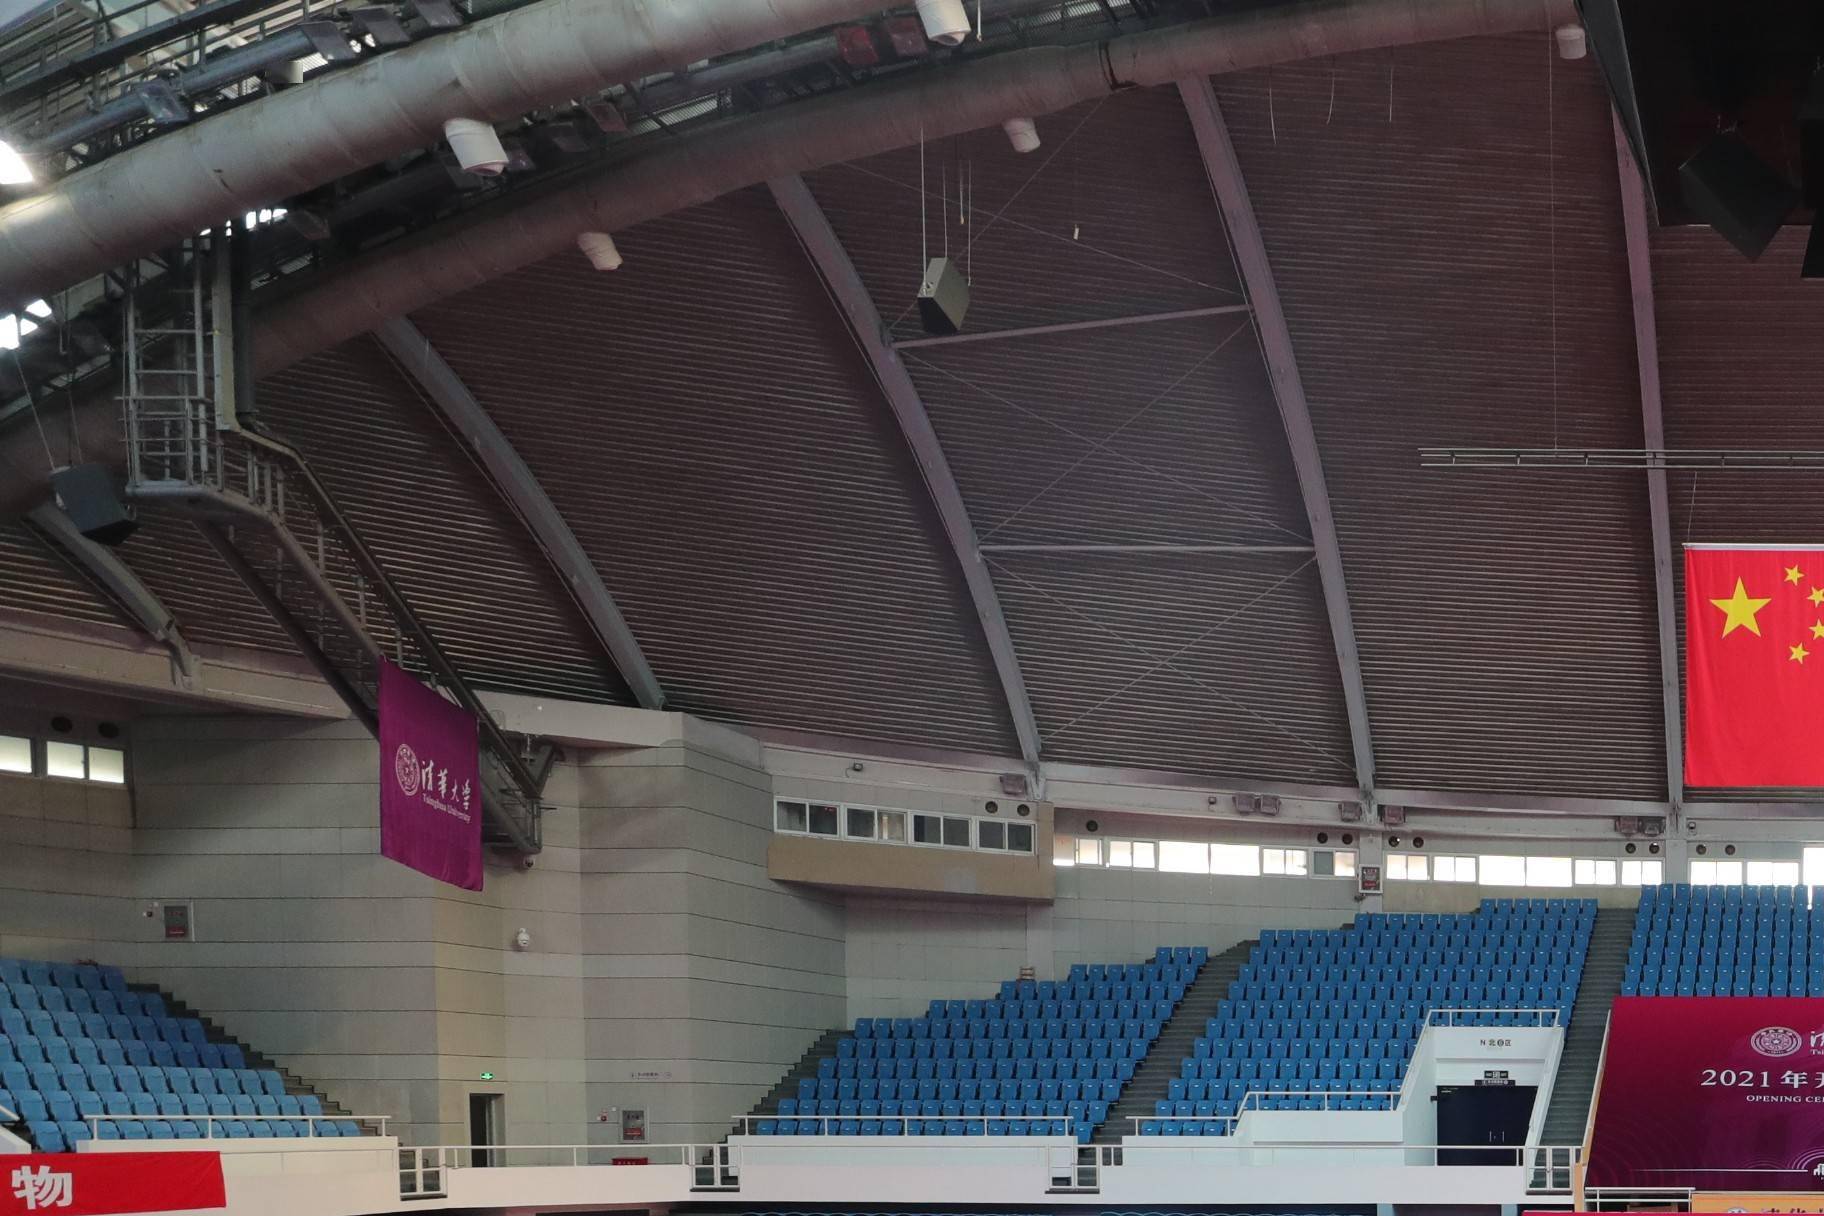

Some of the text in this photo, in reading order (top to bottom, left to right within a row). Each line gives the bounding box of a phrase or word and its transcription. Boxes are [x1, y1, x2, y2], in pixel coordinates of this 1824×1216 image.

[421, 759, 471, 811] 清华大学
[1746, 1095, 1802, 1103] OPENING
[11, 1165, 73, 1210] 物
